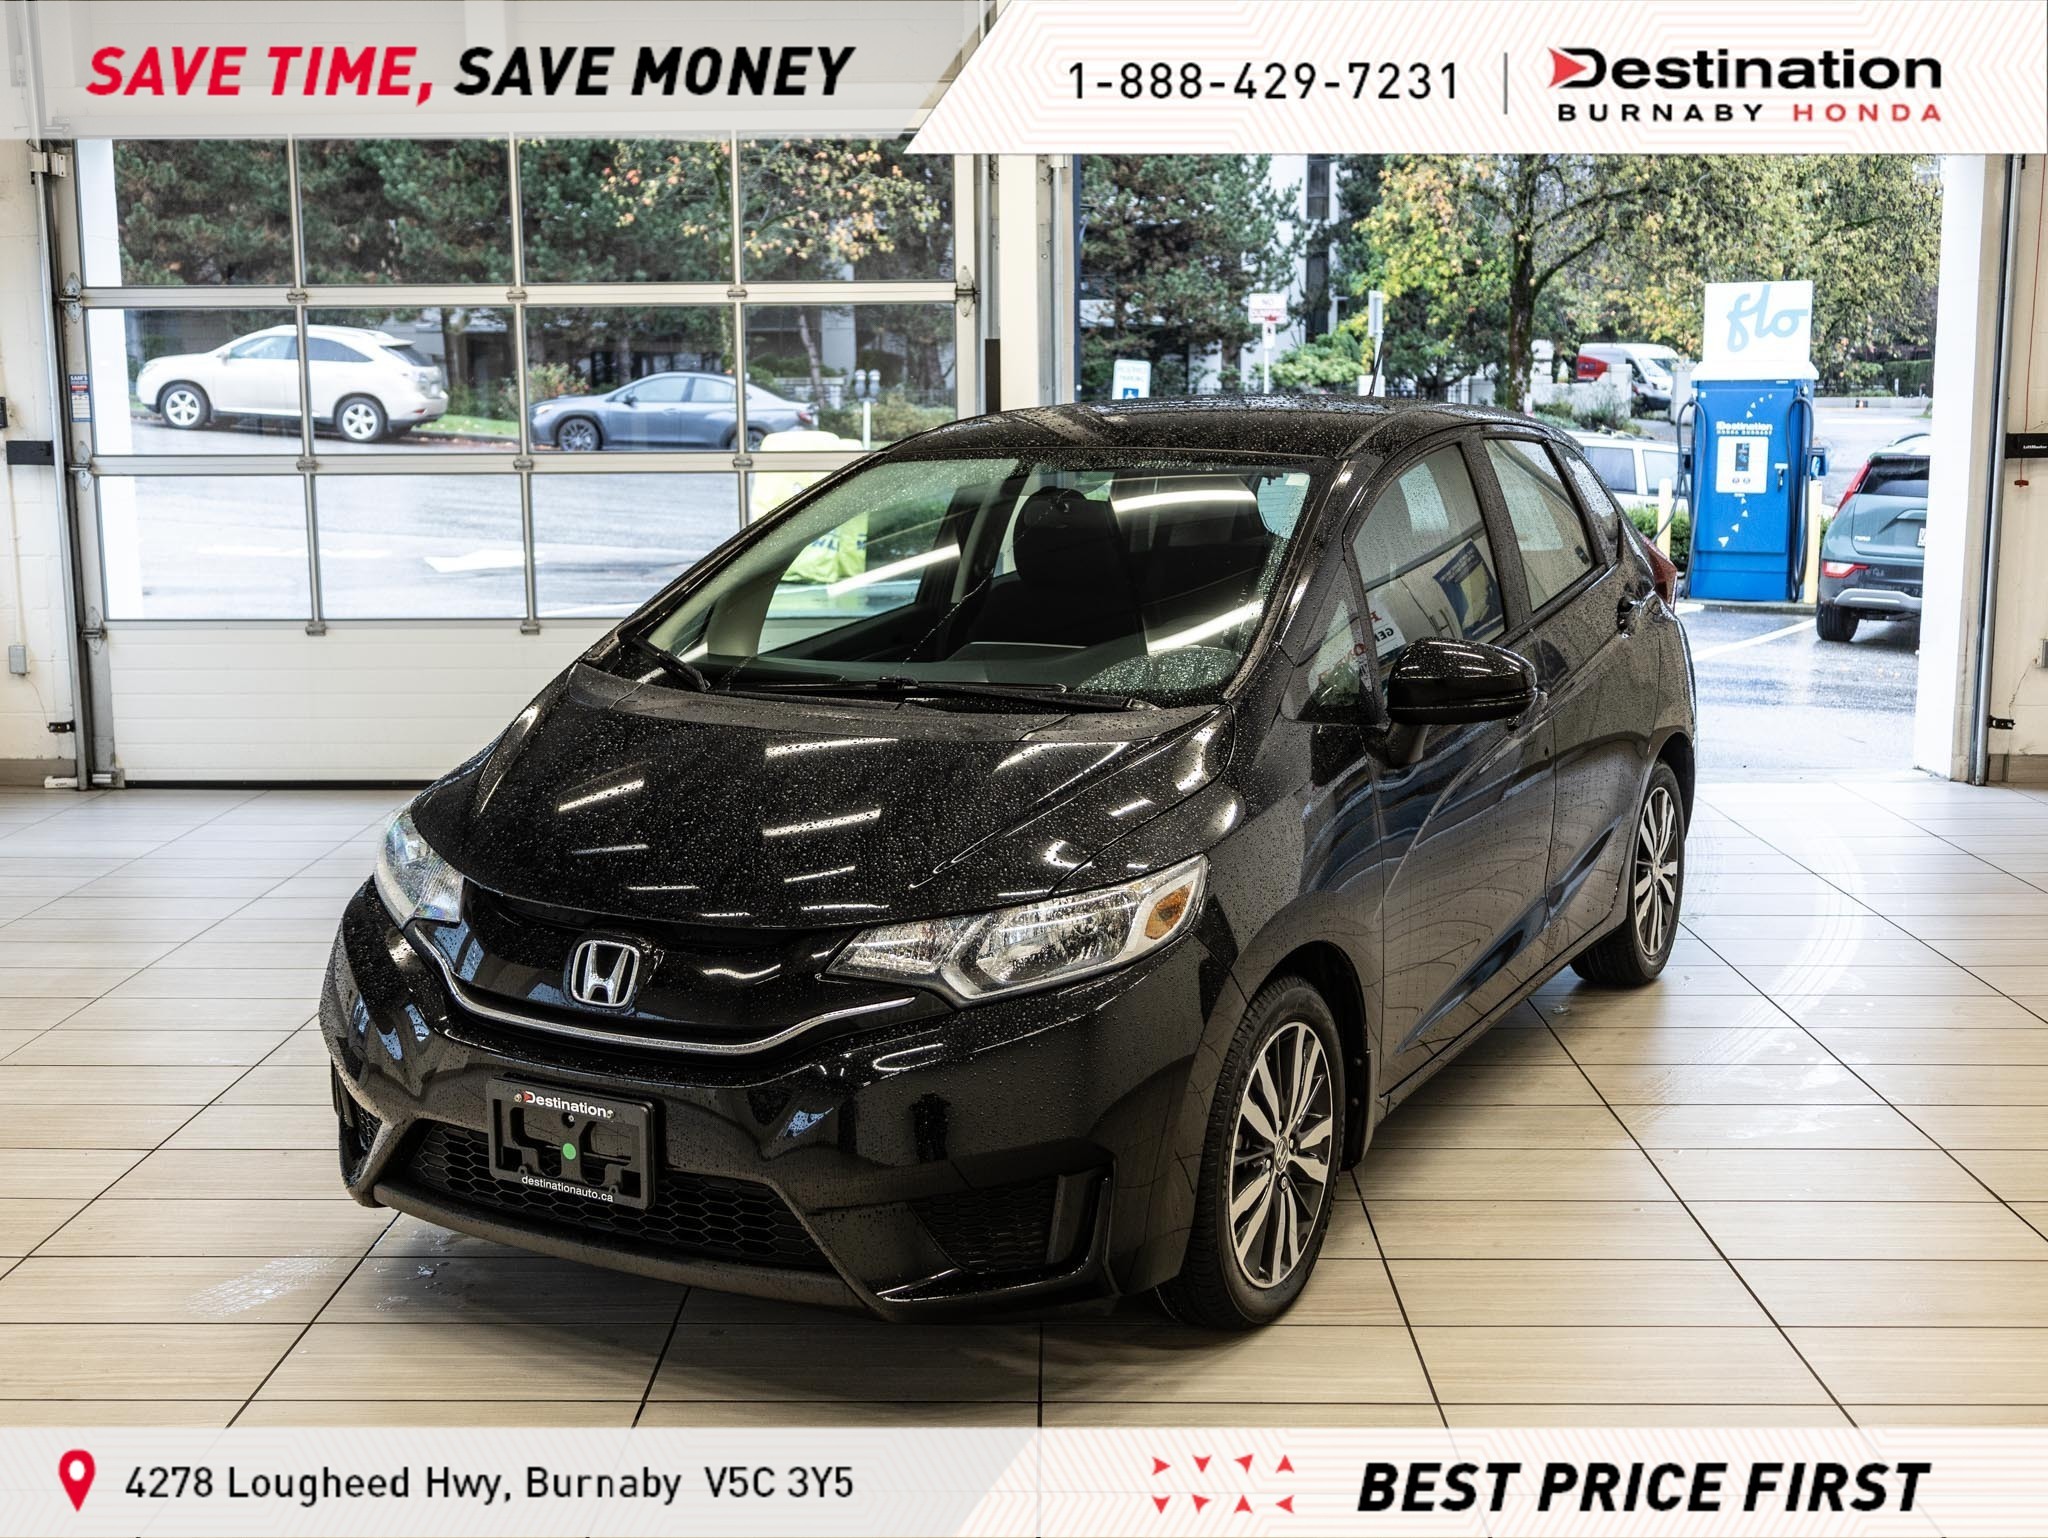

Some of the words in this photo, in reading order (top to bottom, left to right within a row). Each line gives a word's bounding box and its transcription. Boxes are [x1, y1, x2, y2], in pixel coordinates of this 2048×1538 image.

[1727, 284, 1809, 352] flo
[523, 1090, 607, 1118] Destination
[521, 1175, 614, 1203] destinationauto.ca
